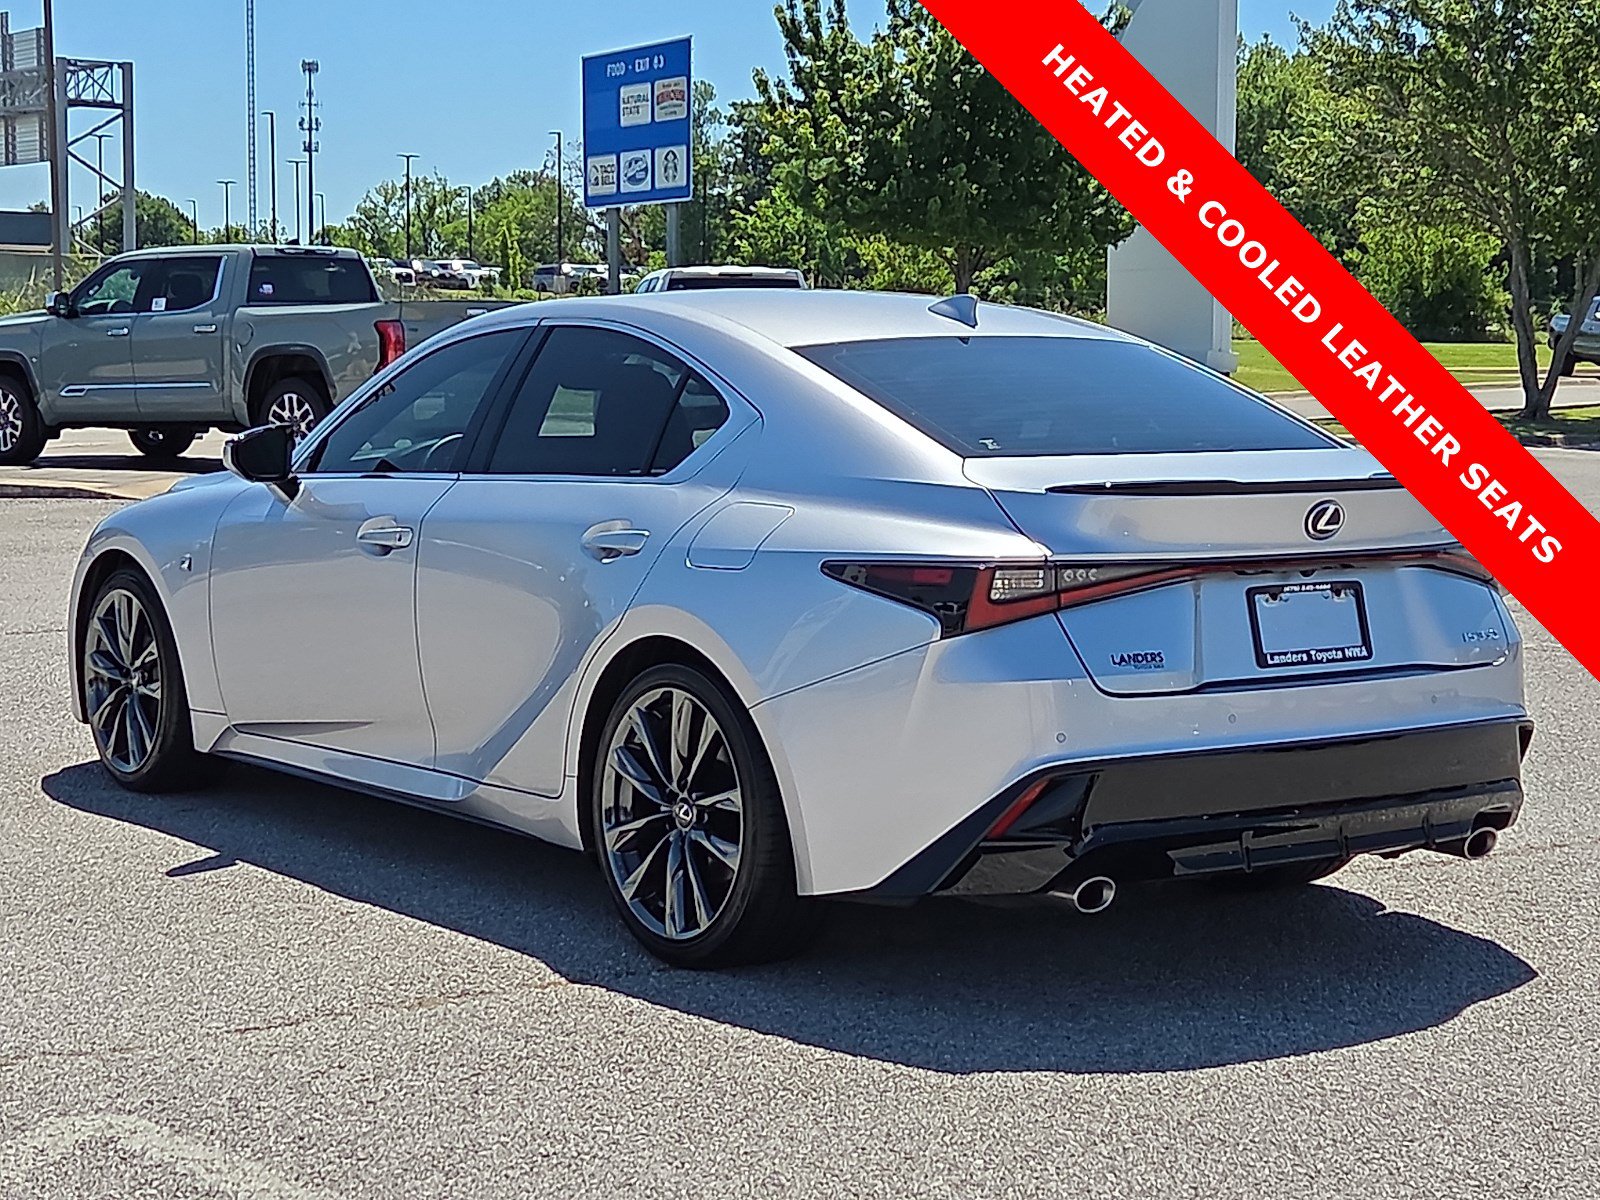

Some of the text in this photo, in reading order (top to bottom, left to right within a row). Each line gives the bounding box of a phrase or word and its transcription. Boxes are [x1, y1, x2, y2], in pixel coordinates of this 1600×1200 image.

[607, 61, 626, 77] FOOD
[635, 57, 650, 73] EXIT
[622, 93, 649, 105] NATURAL
[622, 104, 641, 117] STATE
[1110, 651, 1164, 667] LANDERS
[1267, 652, 1308, 665] Landers
[1310, 649, 1343, 662] Toyota
